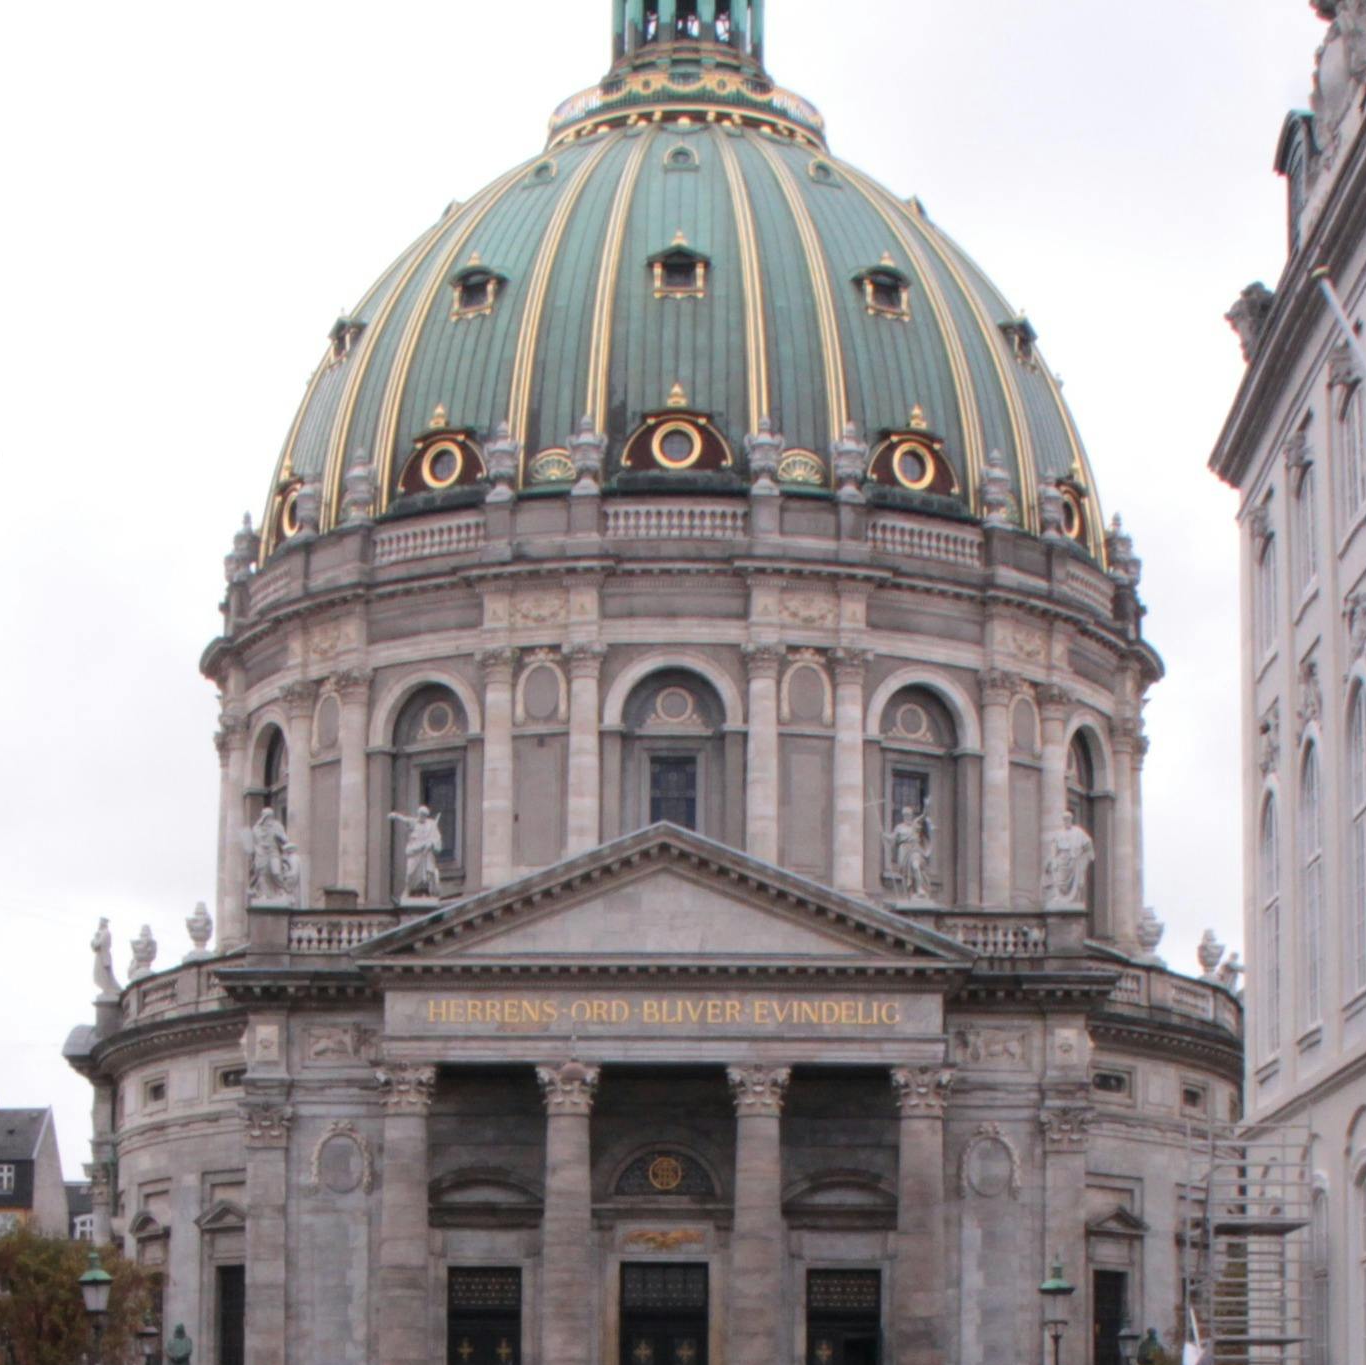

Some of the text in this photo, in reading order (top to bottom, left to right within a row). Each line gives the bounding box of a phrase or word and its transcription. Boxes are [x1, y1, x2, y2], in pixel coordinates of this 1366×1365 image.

[428, 999, 900, 1025] HERRENS ORD BLIVER EVINDELIG
